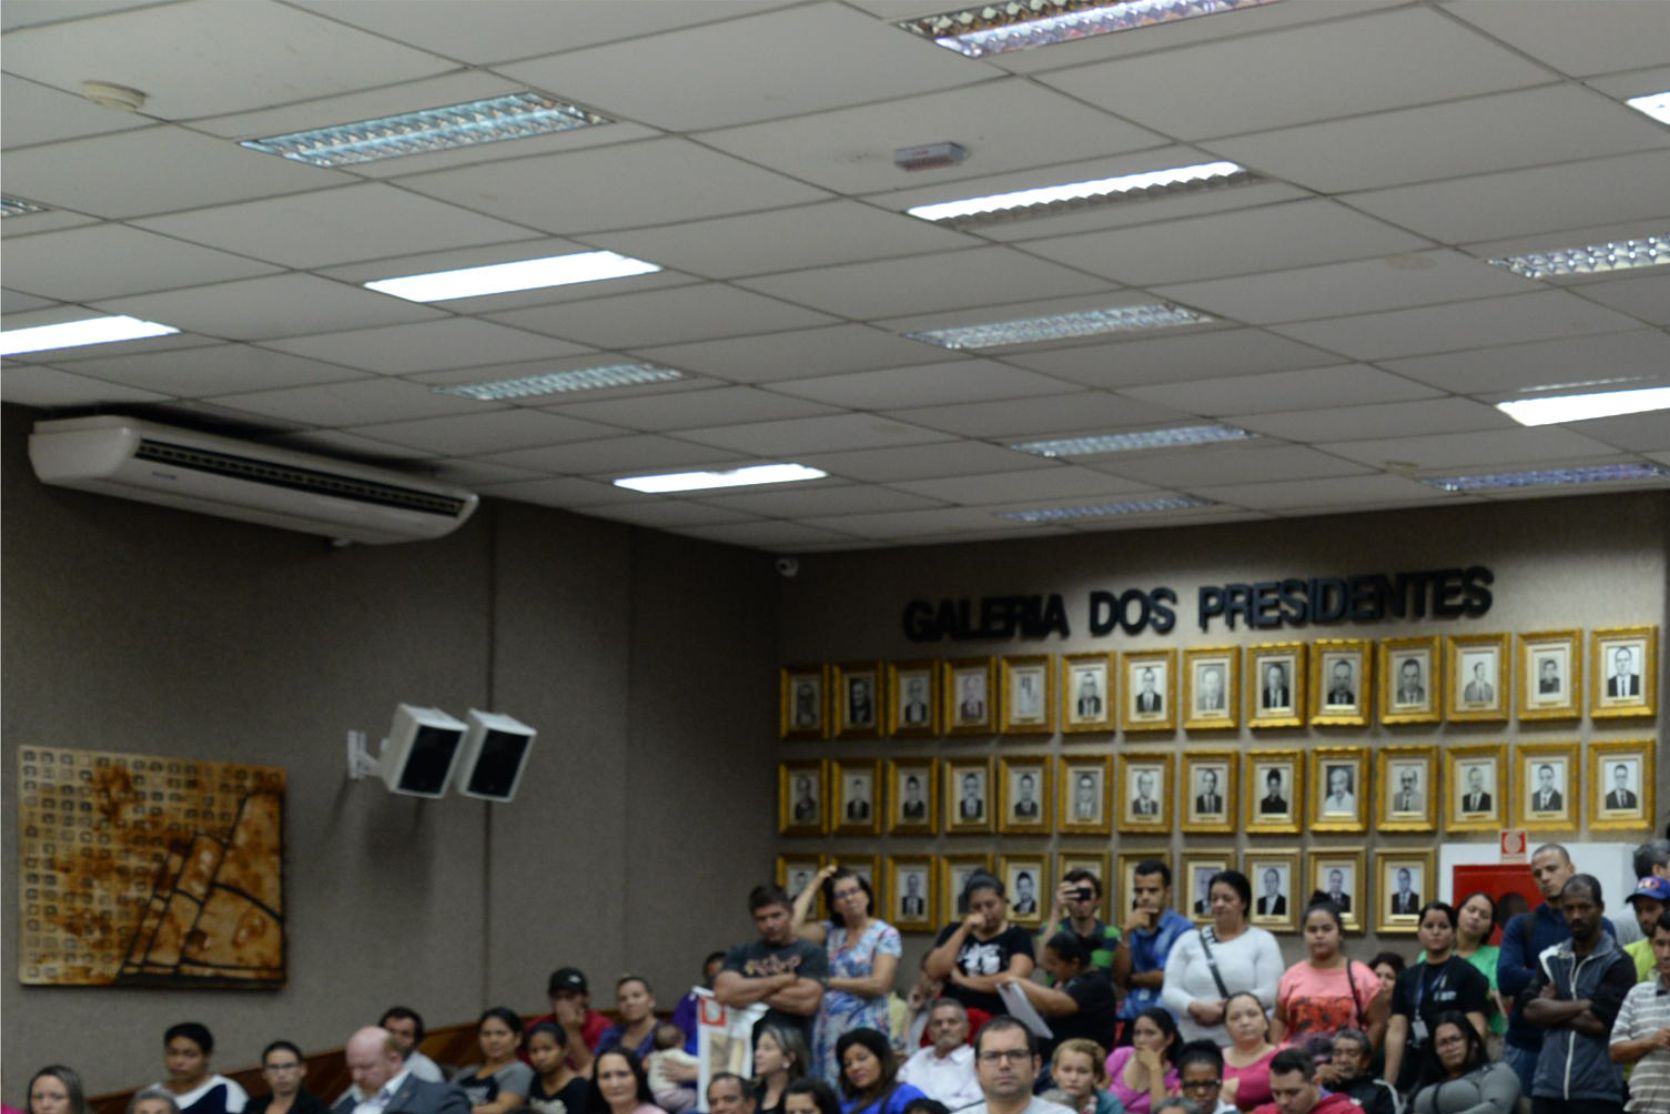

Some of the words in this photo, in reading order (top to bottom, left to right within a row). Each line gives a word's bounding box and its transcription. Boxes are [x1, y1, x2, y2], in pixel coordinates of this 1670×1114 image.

[903, 592, 1070, 643] GALERIA
[1088, 587, 1178, 638] DOS
[1198, 565, 1494, 634] PRESIDENTES
